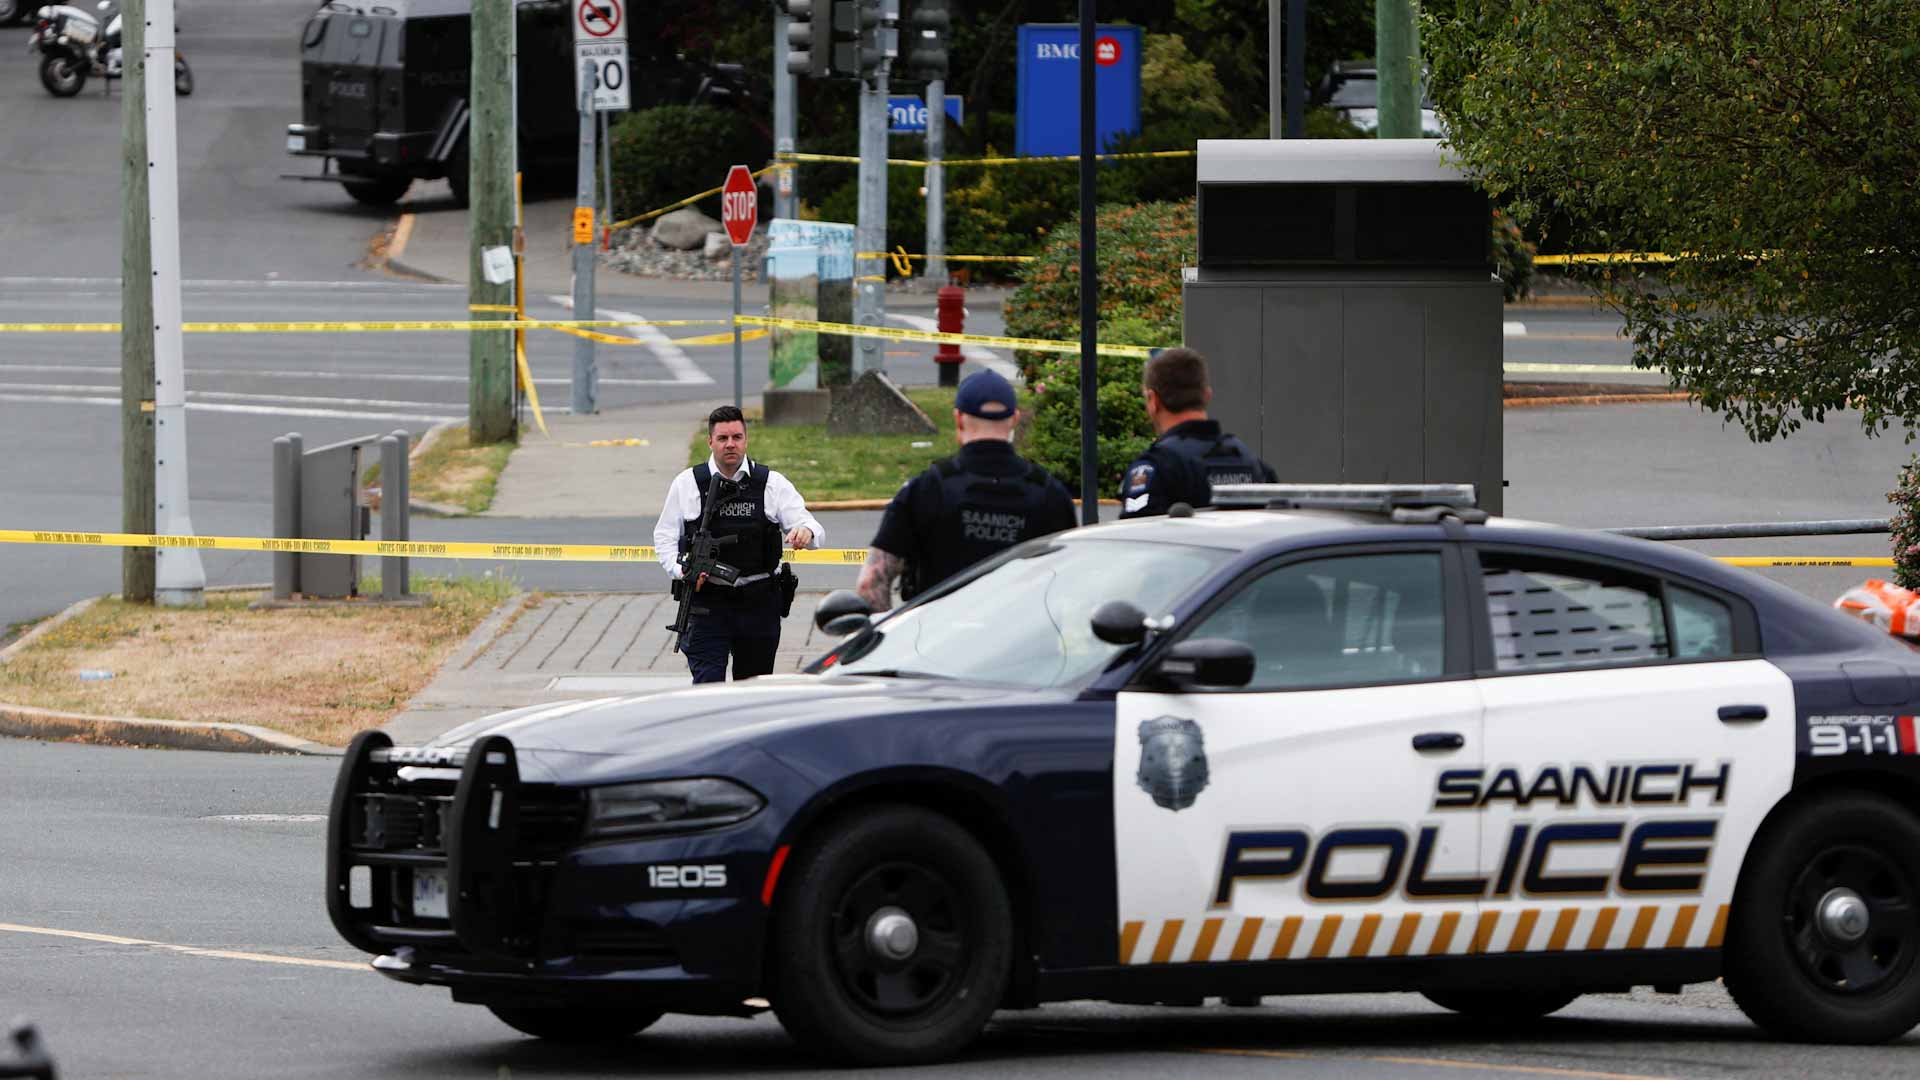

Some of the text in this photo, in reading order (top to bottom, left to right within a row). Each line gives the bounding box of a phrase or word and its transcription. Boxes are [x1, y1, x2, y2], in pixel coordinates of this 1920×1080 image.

[329, 80, 366, 97] POLICE
[724, 191, 756, 220] STOP
[719, 509, 752, 517] POLICE
[961, 510, 1025, 528] SAANICH
[964, 524, 1017, 541] POLICE
[1808, 715, 1894, 725] EMERGENCY
[1810, 725, 1898, 755] 9-1-1
[1432, 761, 1731, 810] SAANICH
[1213, 818, 1720, 906] POLICE
[647, 865, 727, 888] 1205
